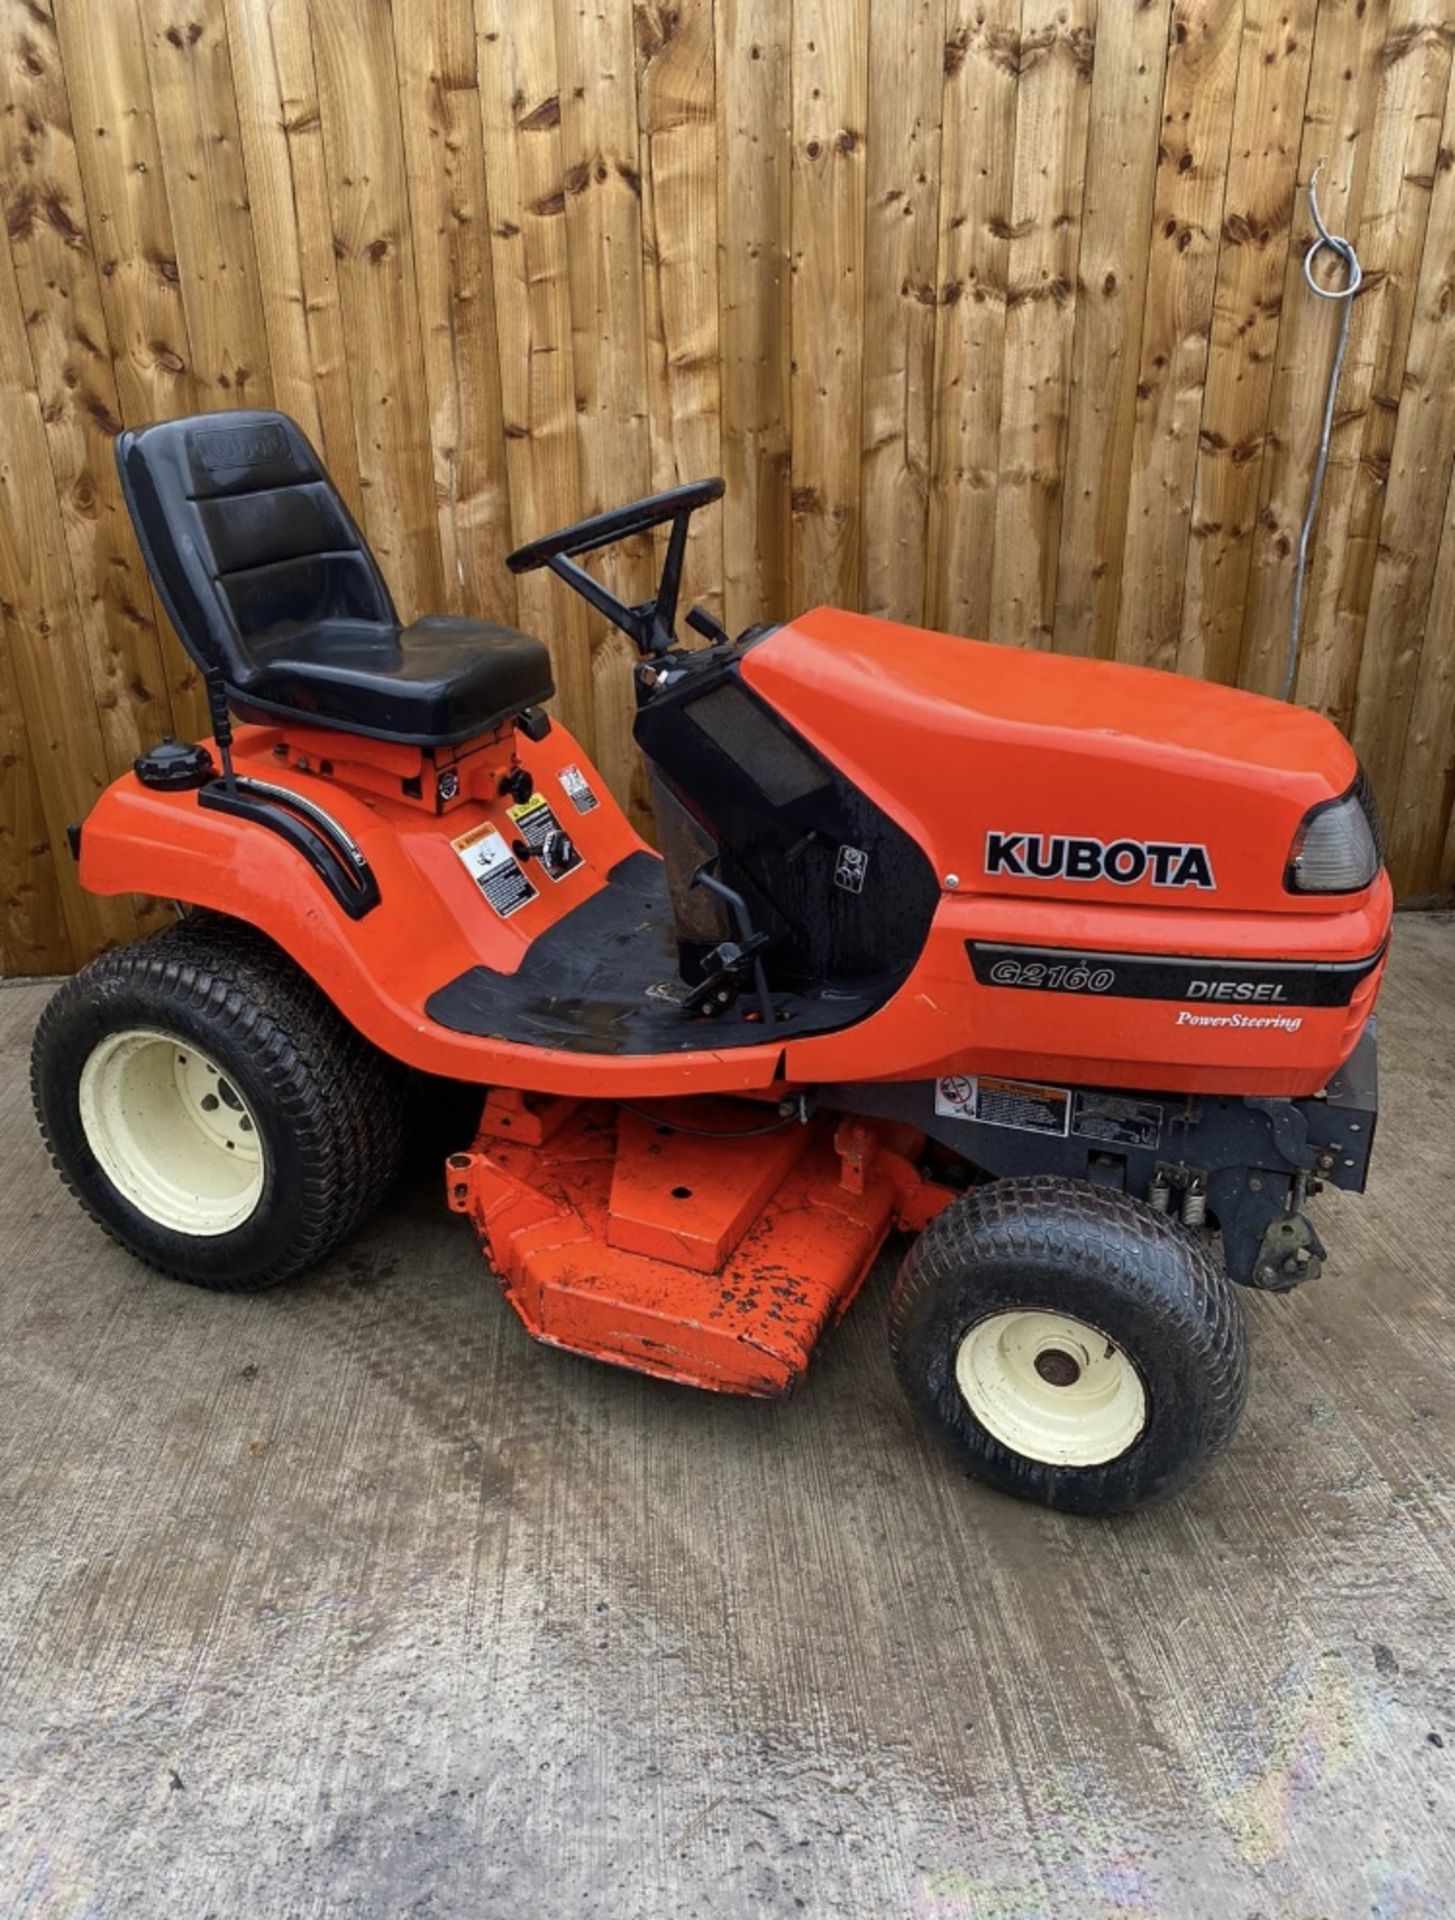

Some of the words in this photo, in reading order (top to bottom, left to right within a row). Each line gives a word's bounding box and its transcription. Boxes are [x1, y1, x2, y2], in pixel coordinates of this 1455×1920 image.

[985, 832, 1216, 889] KUBOTA
[990, 961, 1115, 991] G2160
[1186, 981, 1288, 1001] DIESEL
[1175, 1011, 1302, 1032] PowerSteering
